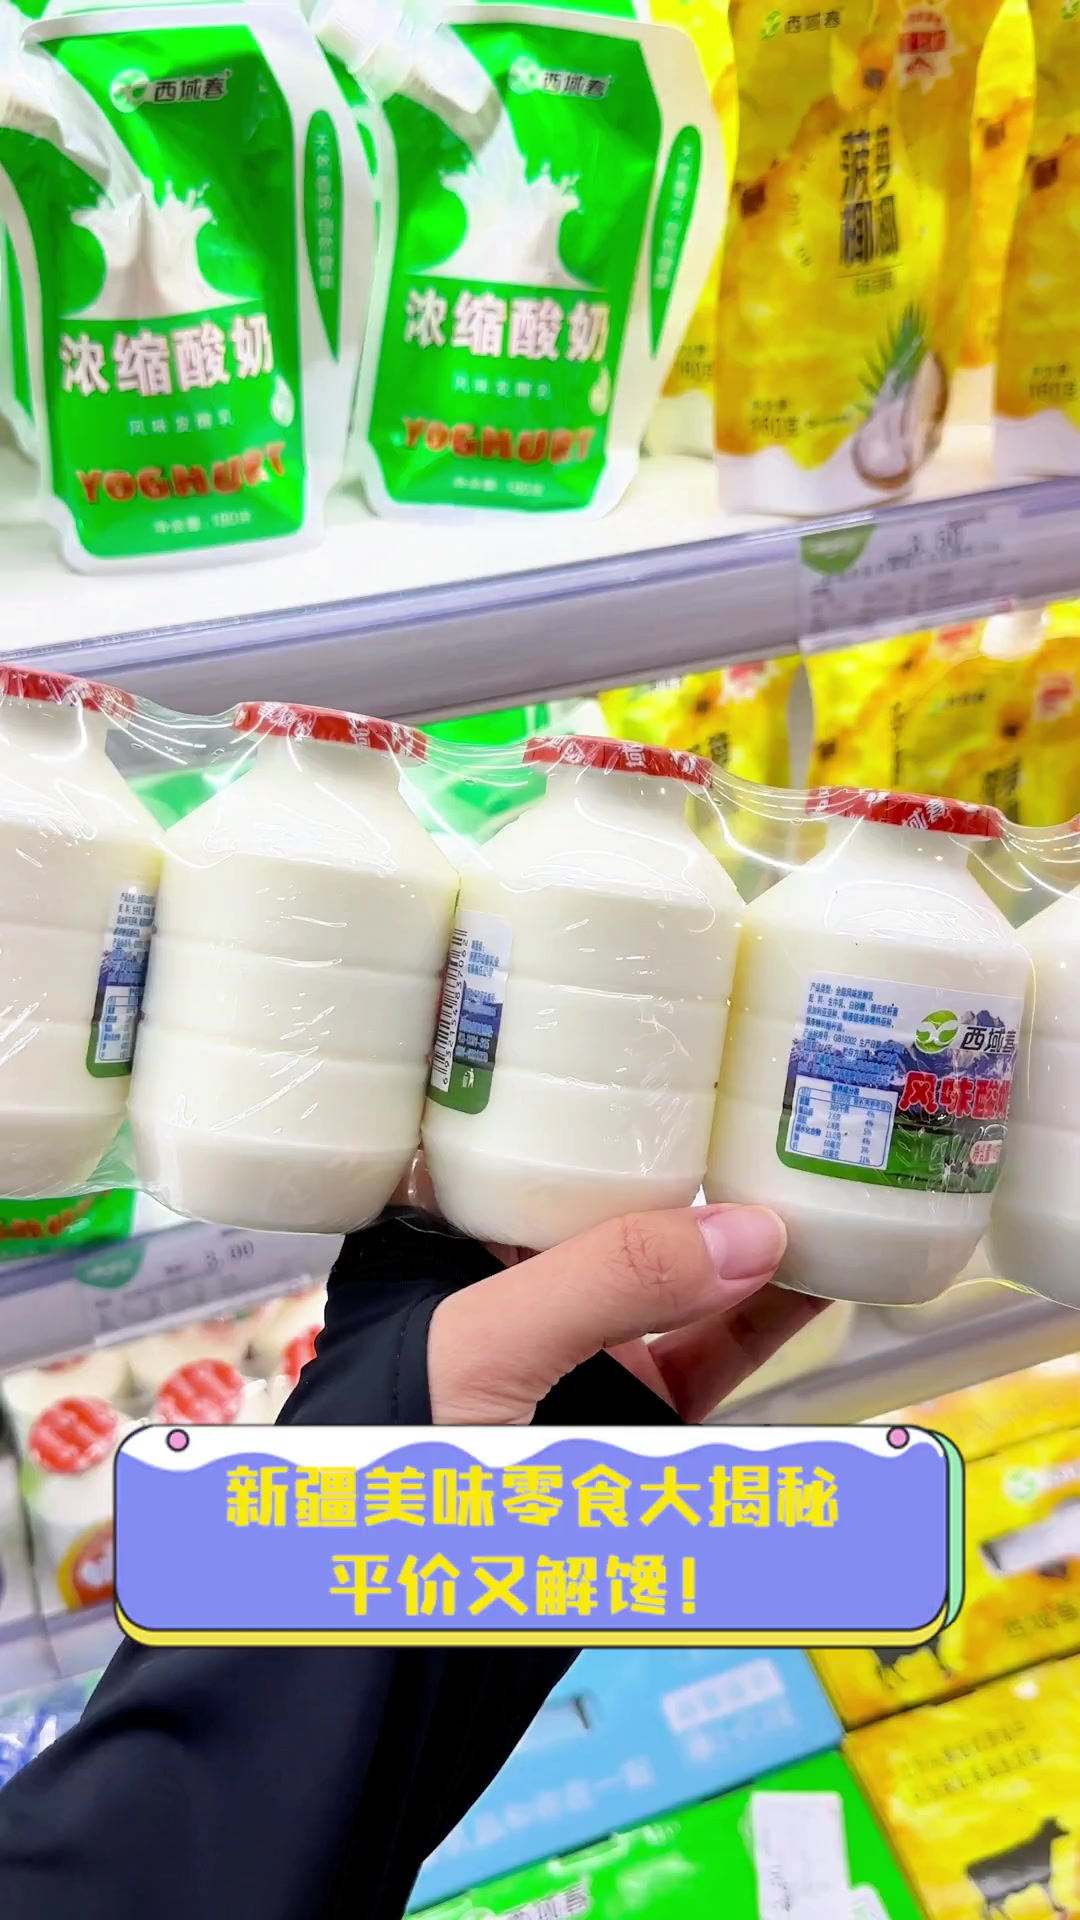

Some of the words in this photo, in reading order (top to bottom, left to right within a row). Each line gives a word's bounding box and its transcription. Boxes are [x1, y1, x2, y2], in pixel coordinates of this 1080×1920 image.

[154, 77, 225, 102] 西域春
[544, 71, 606, 97] 西域春
[404, 286, 610, 363] 浓缩酸奶
[60, 313, 275, 398] 浓缩酸奶
[130, 408, 233, 436] 风味发酵乳
[404, 417, 596, 464] YOGHURT
[75, 441, 286, 504] YOGHURT
